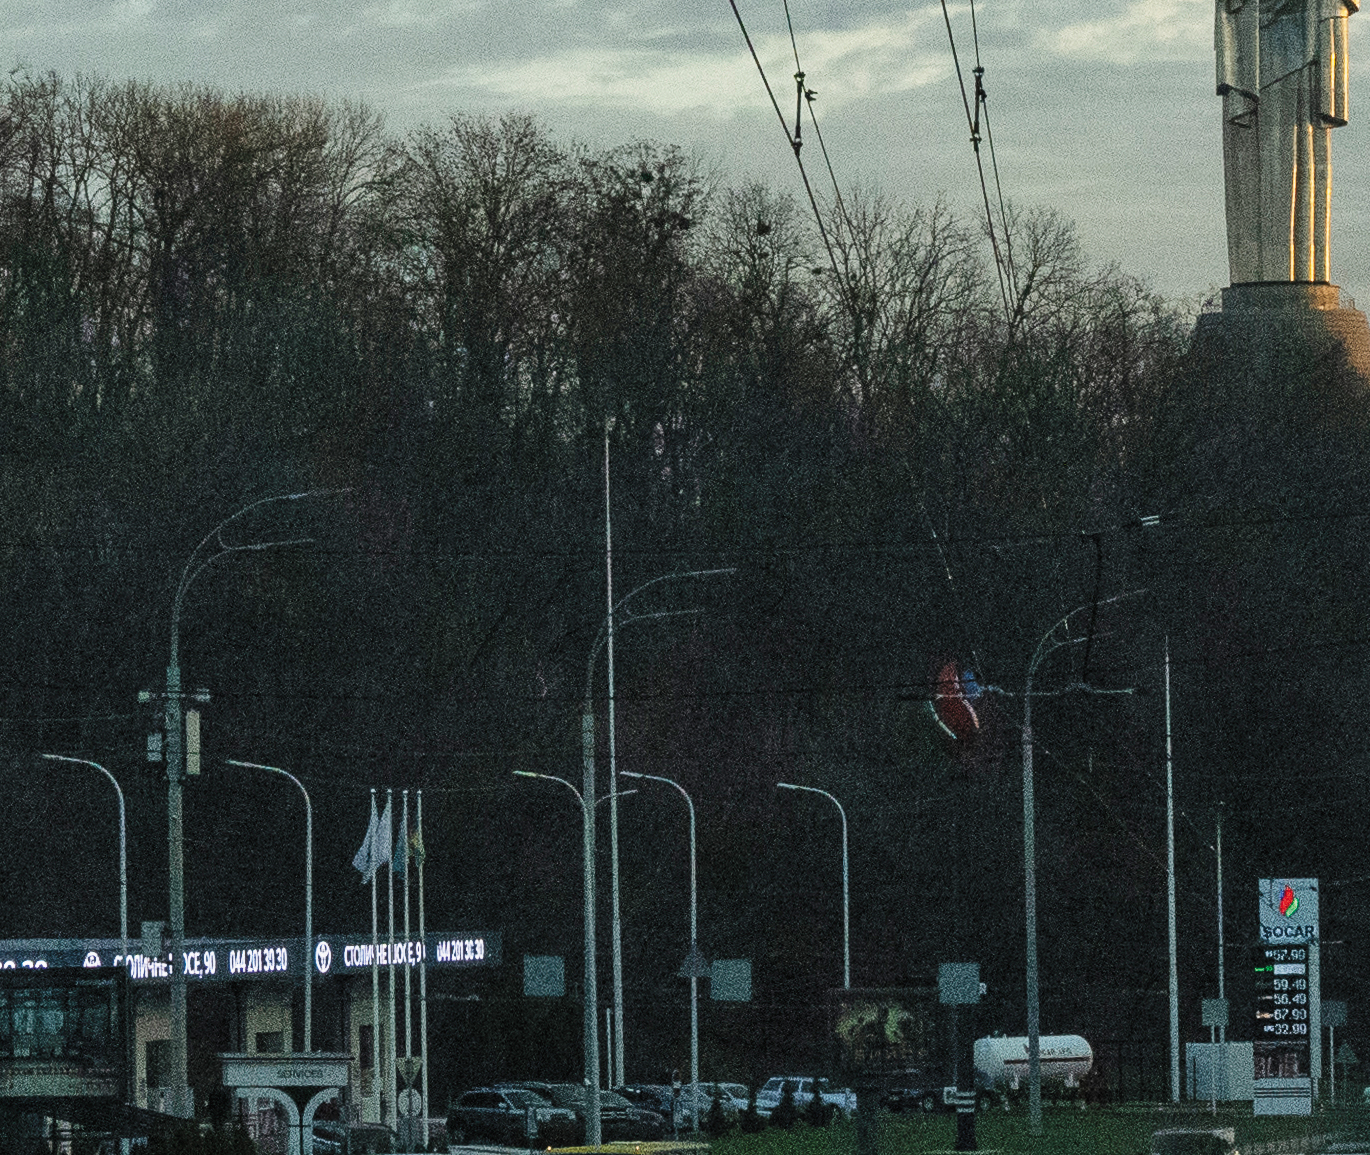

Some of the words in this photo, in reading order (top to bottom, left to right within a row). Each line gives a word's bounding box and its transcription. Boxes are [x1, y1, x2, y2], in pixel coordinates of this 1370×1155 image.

[1263, 925, 1315, 939] SOCAR
[204, 951, 216, 974] 90
[229, 950, 246, 973] 044
[247, 949, 262, 972] 201
[263, 948, 275, 971] 30
[276, 947, 288, 970] 30
[451, 940, 463, 961] 201
[474, 938, 484, 960] 30
